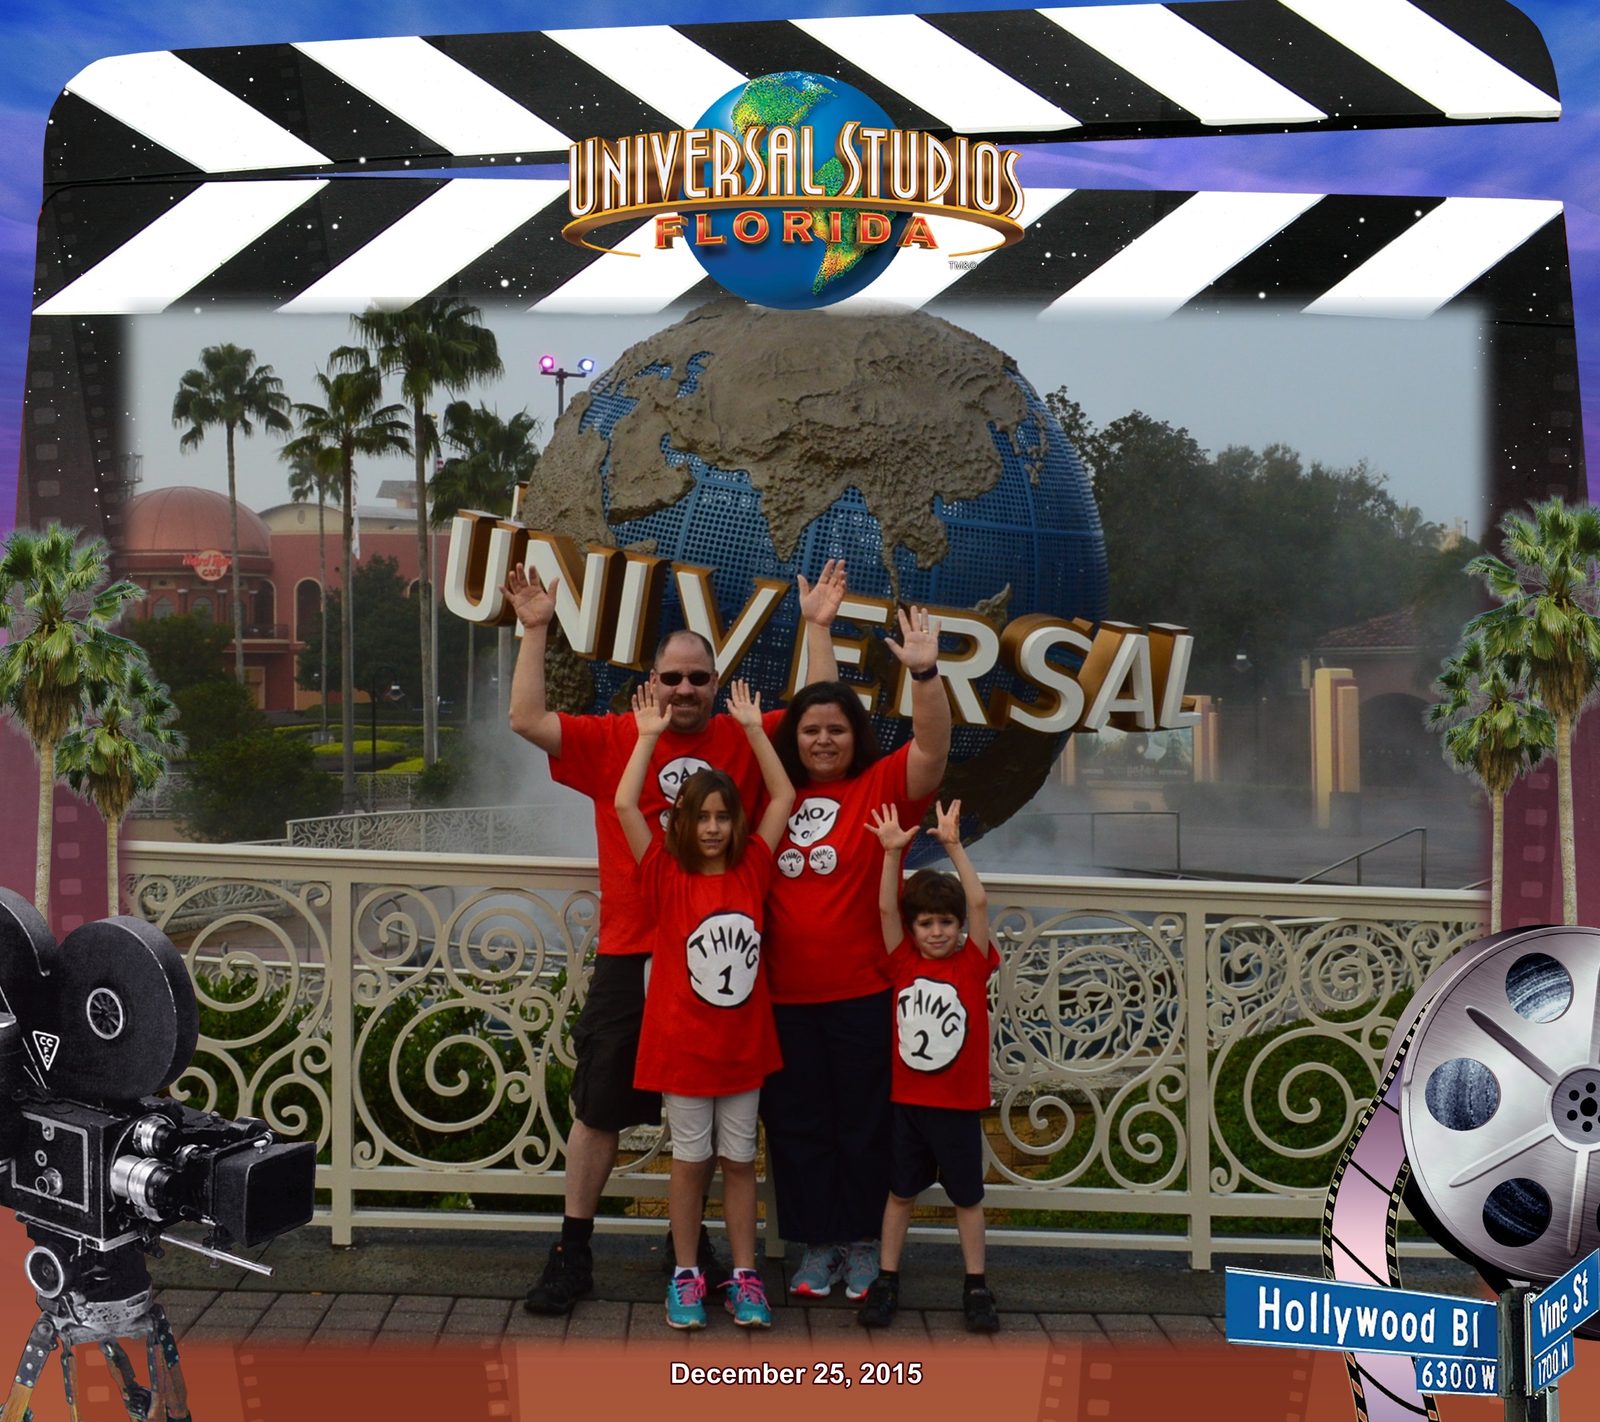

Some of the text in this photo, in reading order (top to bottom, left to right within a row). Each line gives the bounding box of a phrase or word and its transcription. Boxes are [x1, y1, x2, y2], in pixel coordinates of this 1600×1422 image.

[443, 509, 1202, 734] UNIVERSAL
[781, 851, 802, 864] THING
[788, 862, 795, 872] 1
[810, 848, 834, 862] THING
[820, 861, 828, 870] 2
[688, 926, 760, 970] THING
[717, 965, 735, 996] 1
[897, 988, 960, 1038] THING
[911, 1029, 934, 1061] 2
